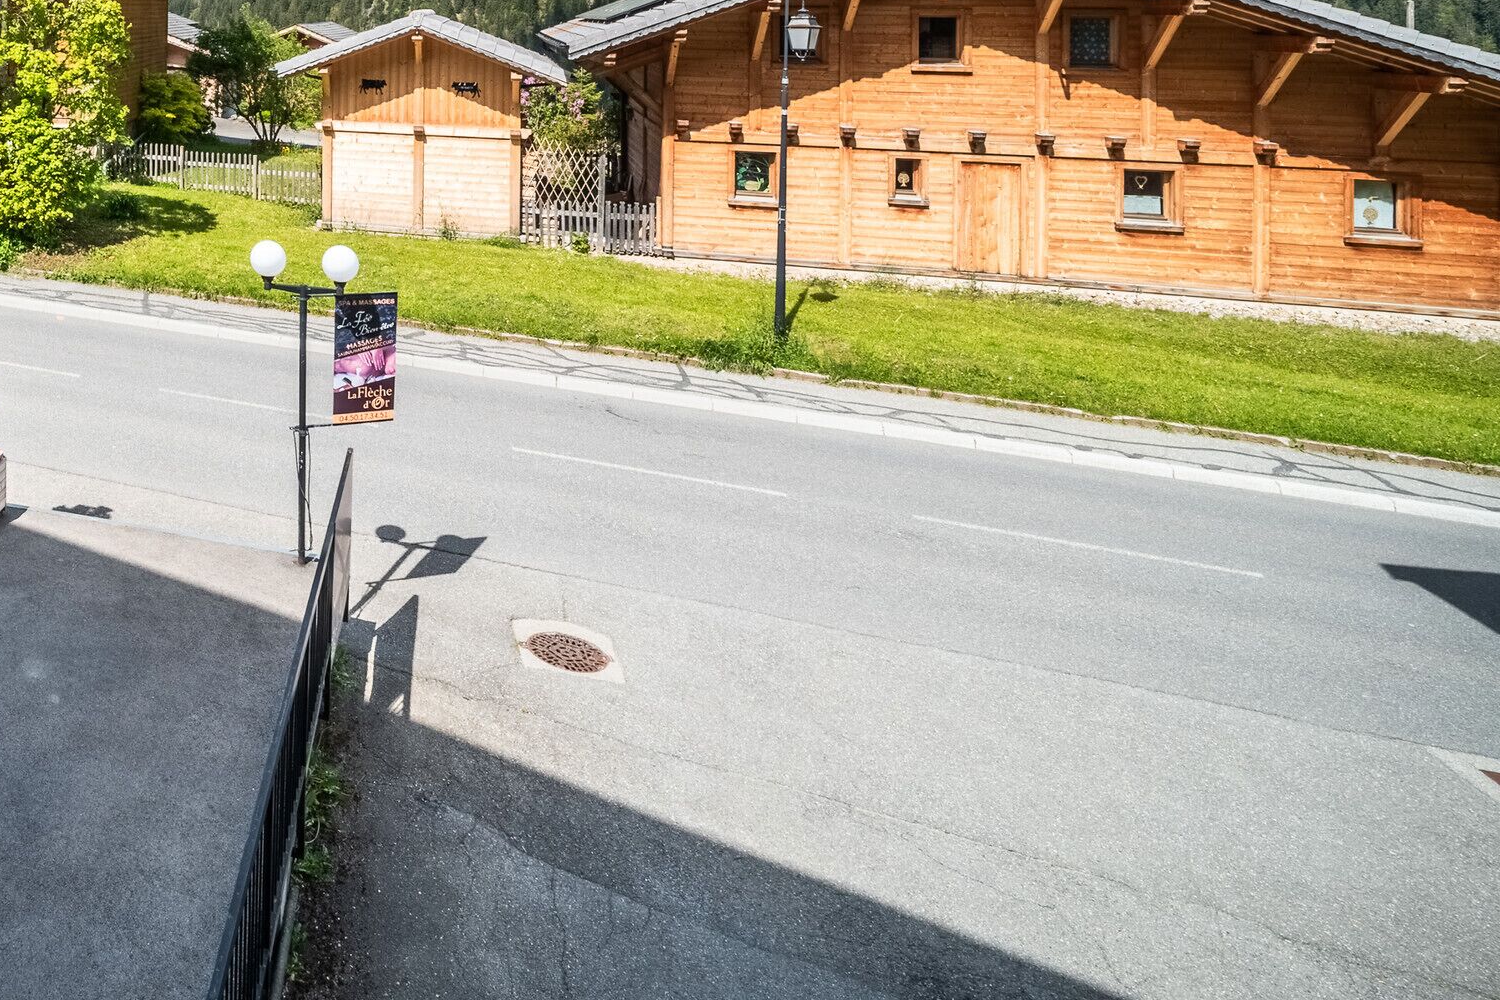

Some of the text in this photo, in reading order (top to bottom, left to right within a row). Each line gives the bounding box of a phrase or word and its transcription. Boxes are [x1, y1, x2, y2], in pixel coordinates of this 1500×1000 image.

[336, 310, 373, 330] La Fée
[346, 335, 383, 350] MASSAGES
[347, 384, 393, 400] La Flèche
